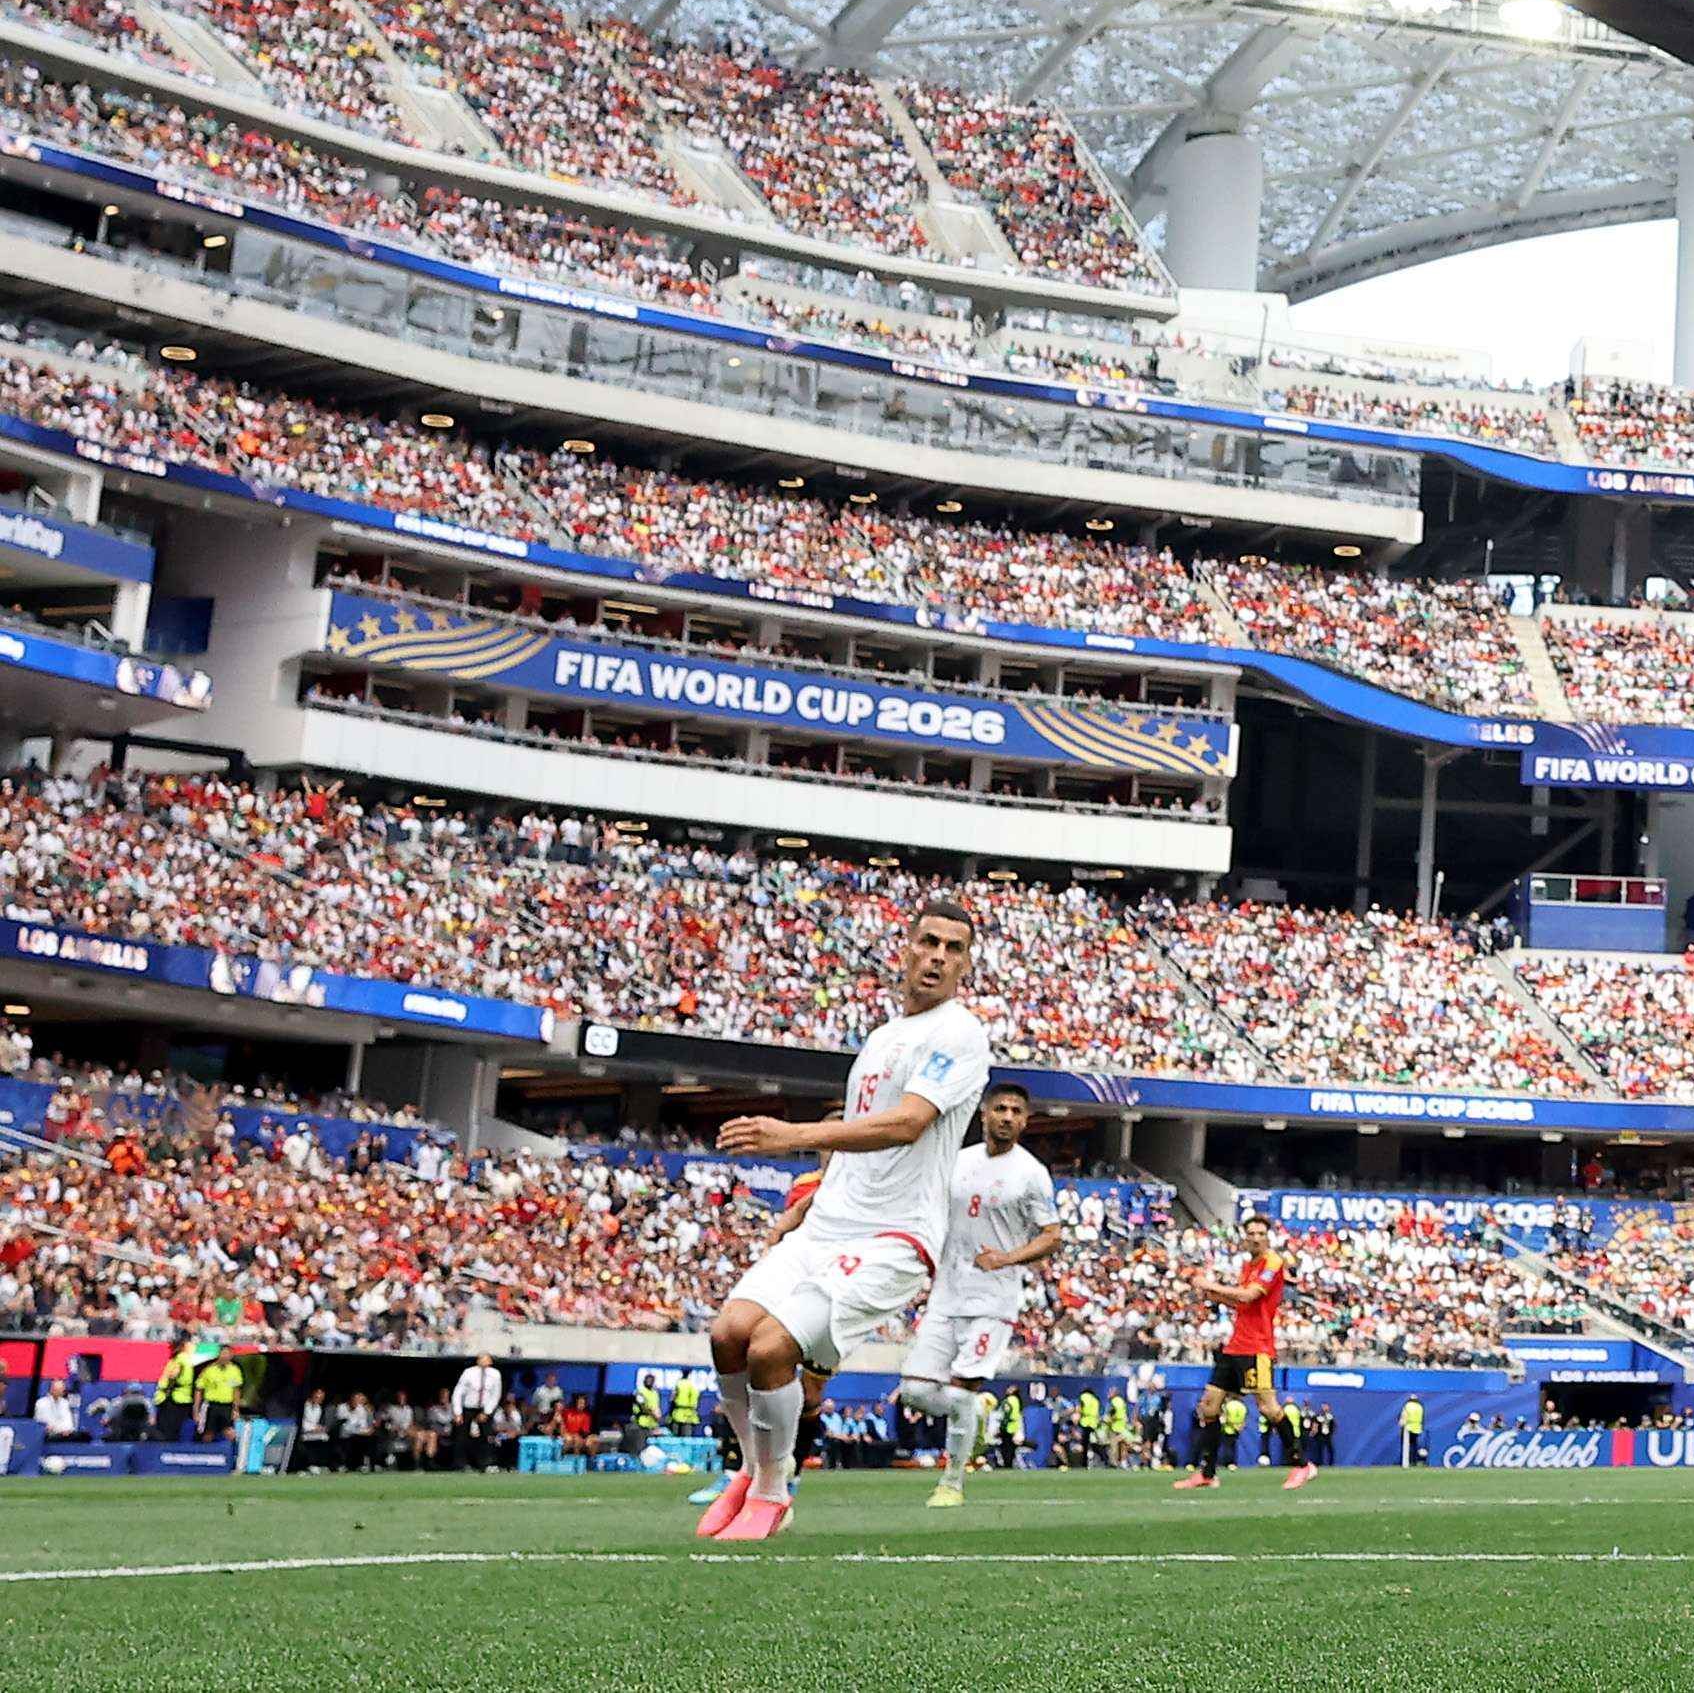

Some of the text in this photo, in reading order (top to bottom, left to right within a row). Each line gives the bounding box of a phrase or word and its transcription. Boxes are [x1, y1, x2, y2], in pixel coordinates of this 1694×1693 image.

[554, 649, 1005, 744] FIFA WORLD CUP 2026
[1534, 756, 1592, 782] FIFA
[1594, 759, 1690, 786] WORLD
[1310, 1092, 1354, 1113] FIFA
[1354, 1094, 1426, 1117] WORLD
[1426, 1097, 1465, 1118] CUP
[967, 1194, 982, 1218] 8
[1280, 1194, 1340, 1222] FIFA
[1443, 1428, 1603, 1469] Michelob
